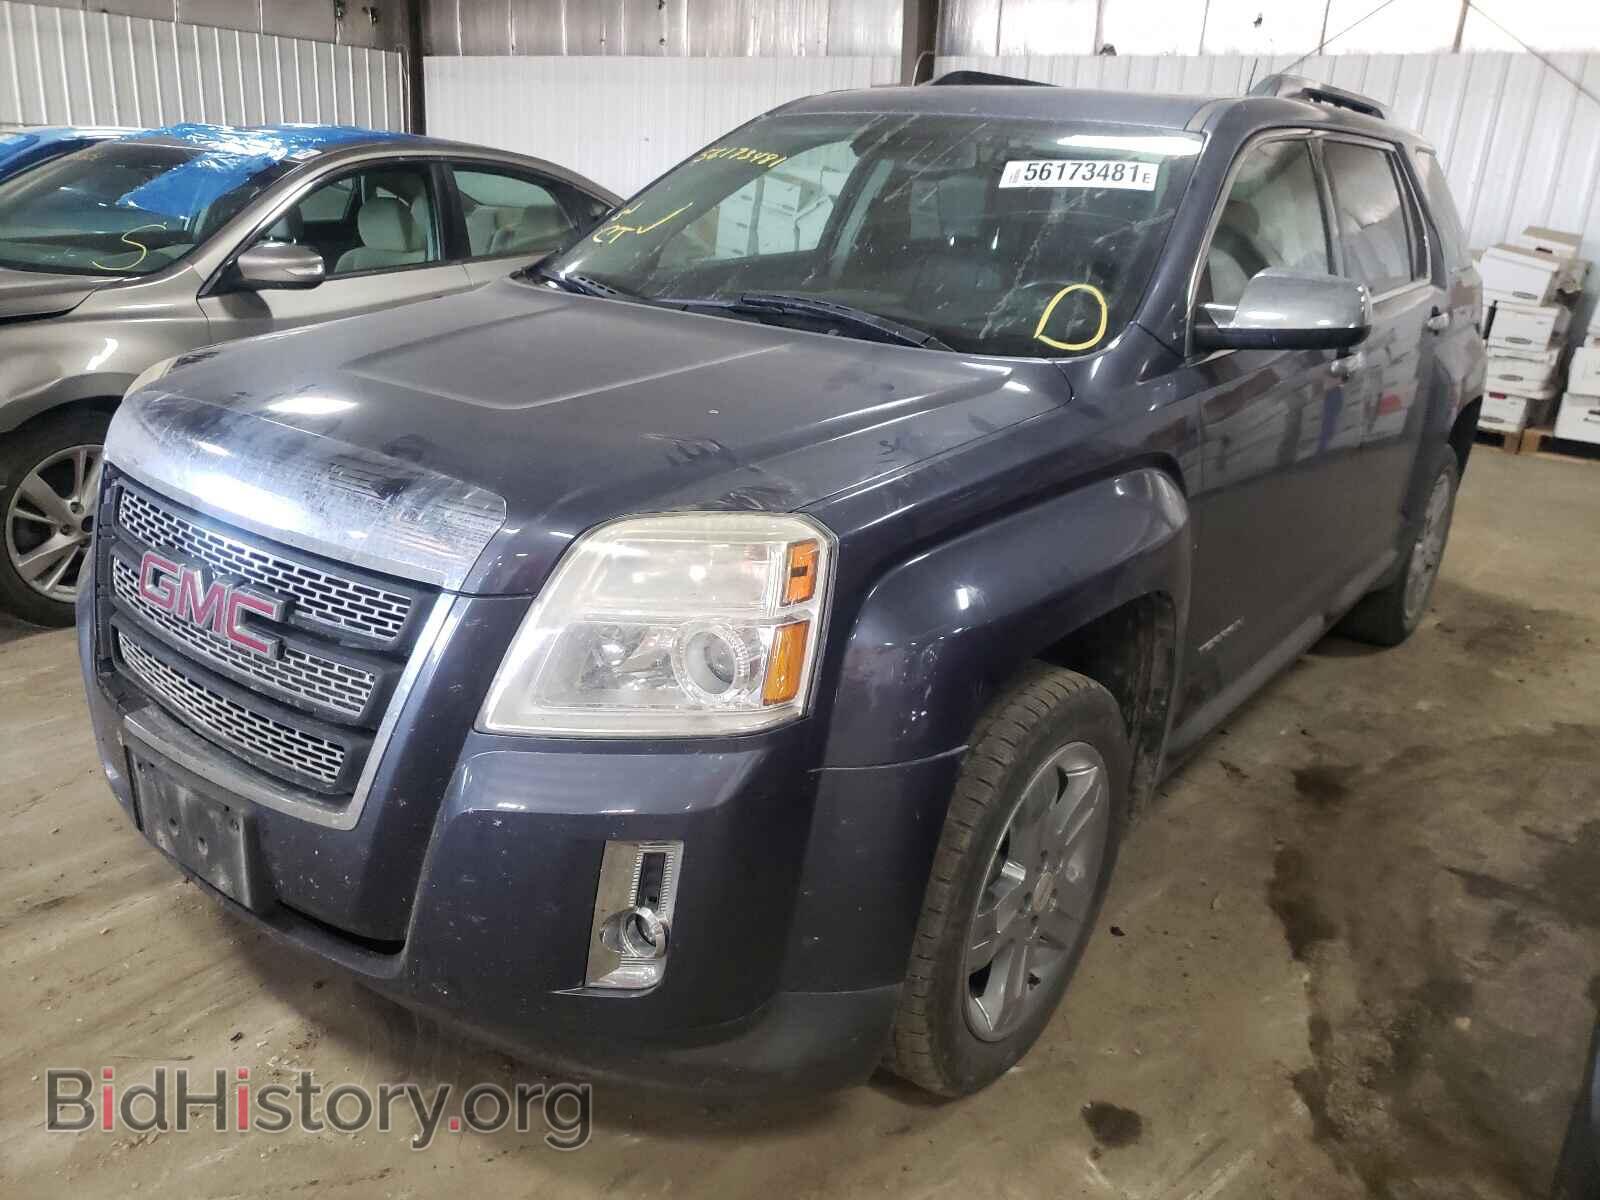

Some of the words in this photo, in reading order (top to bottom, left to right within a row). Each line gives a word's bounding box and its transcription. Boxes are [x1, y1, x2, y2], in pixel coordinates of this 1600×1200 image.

[1024, 162, 1139, 183] 56173481
[1142, 172, 1151, 184] E
[139, 551, 282, 659] GMC
